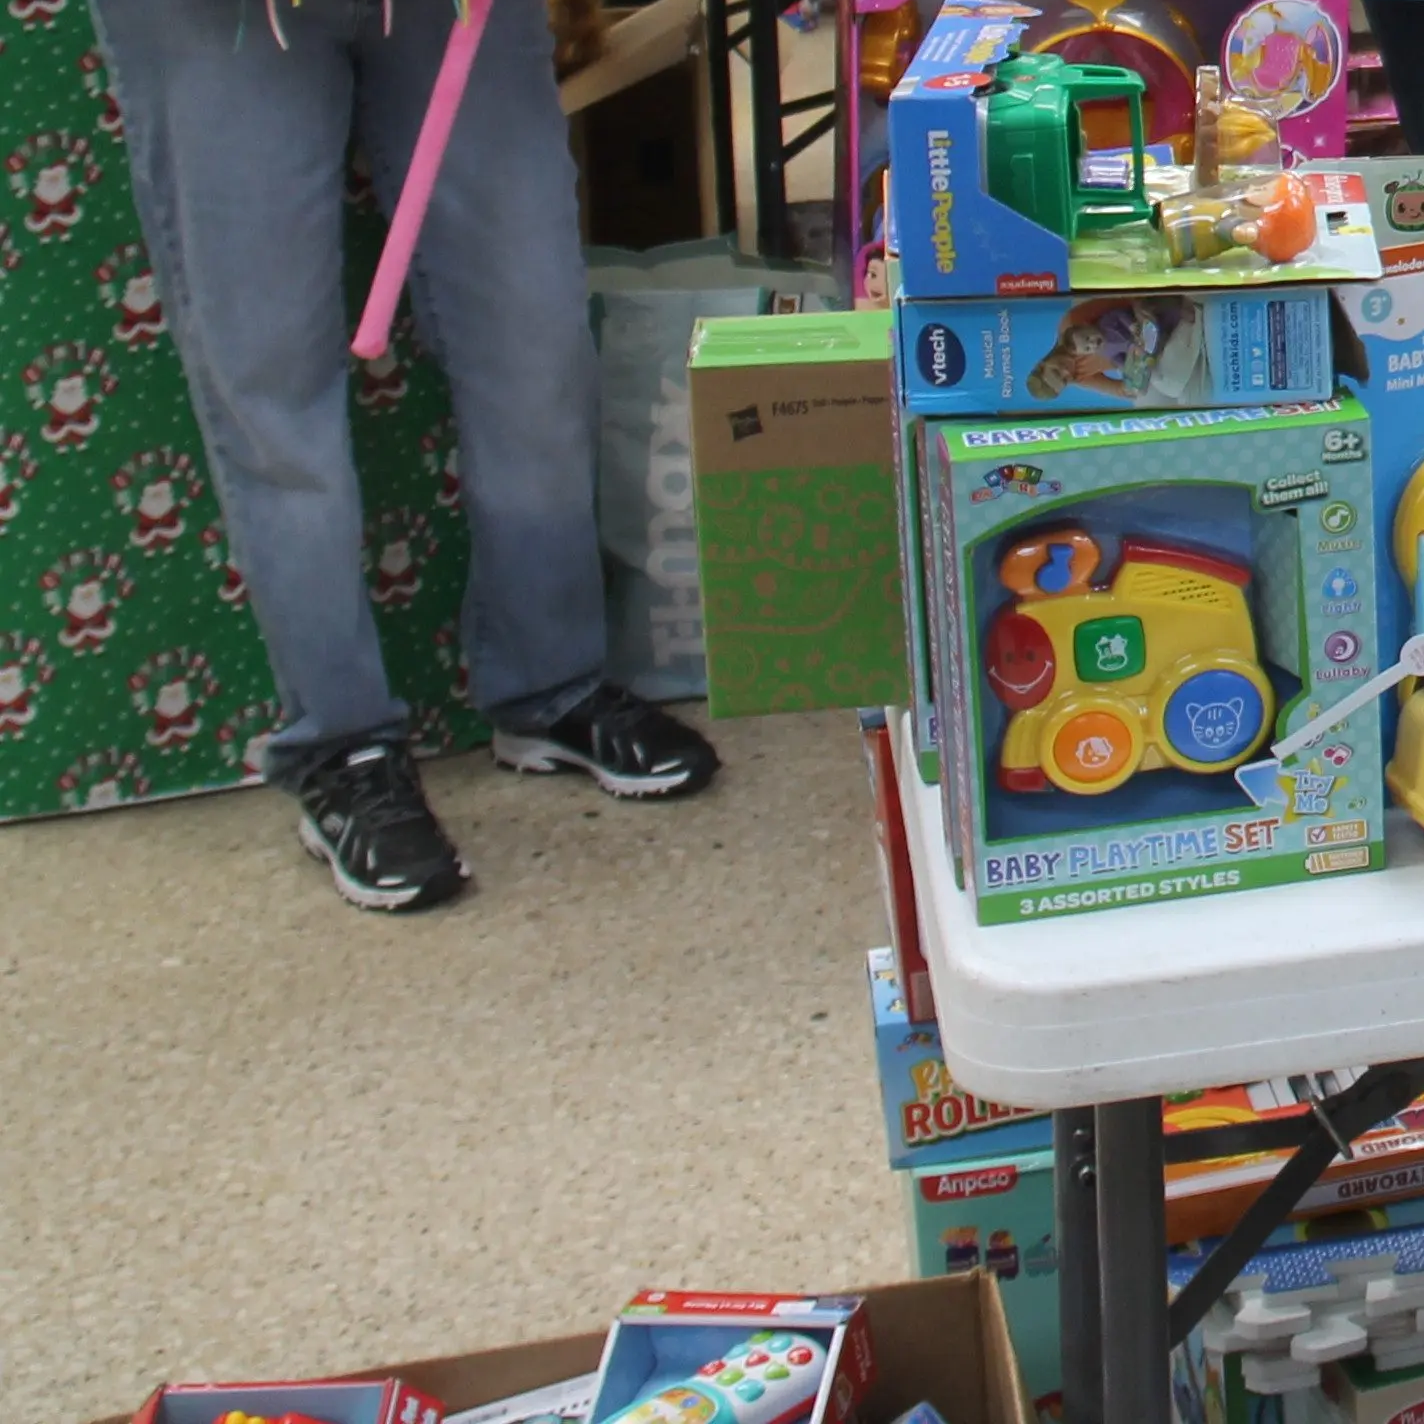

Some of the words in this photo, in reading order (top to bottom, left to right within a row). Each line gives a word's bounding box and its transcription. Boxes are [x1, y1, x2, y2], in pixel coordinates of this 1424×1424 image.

[926, 129, 955, 191] Little
[928, 190, 958, 275] People
[1001, 308, 1012, 355] Book
[1229, 301, 1241, 393] vtechkids.com
[933, 327, 950, 385] vtech
[983, 330, 995, 379] Musical
[1001, 357, 1013, 400] Rhymes
[1386, 376, 1414, 393] Mini
[962, 425, 1065, 449] BABY
[1069, 405, 1270, 439] PLAYTIME
[1269, 398, 1344, 418] SET
[1323, 430, 1361, 452] 6+
[1321, 449, 1364, 462] Months
[1262, 485, 1304, 506] them
[1305, 481, 1328, 497] all!
[1266, 470, 1321, 490] Collect
[1316, 665, 1371, 681] Lullaby
[1293, 769, 1335, 796] Try
[1293, 792, 1330, 815] Me
[985, 852, 1062, 885] BABY
[1069, 827, 1218, 875] PLAYTIME
[1223, 817, 1280, 853] SET
[1020, 898, 1034, 915] 3
[1038, 882, 1156, 913] ASSORTED
[1158, 869, 1241, 895] STYLES
